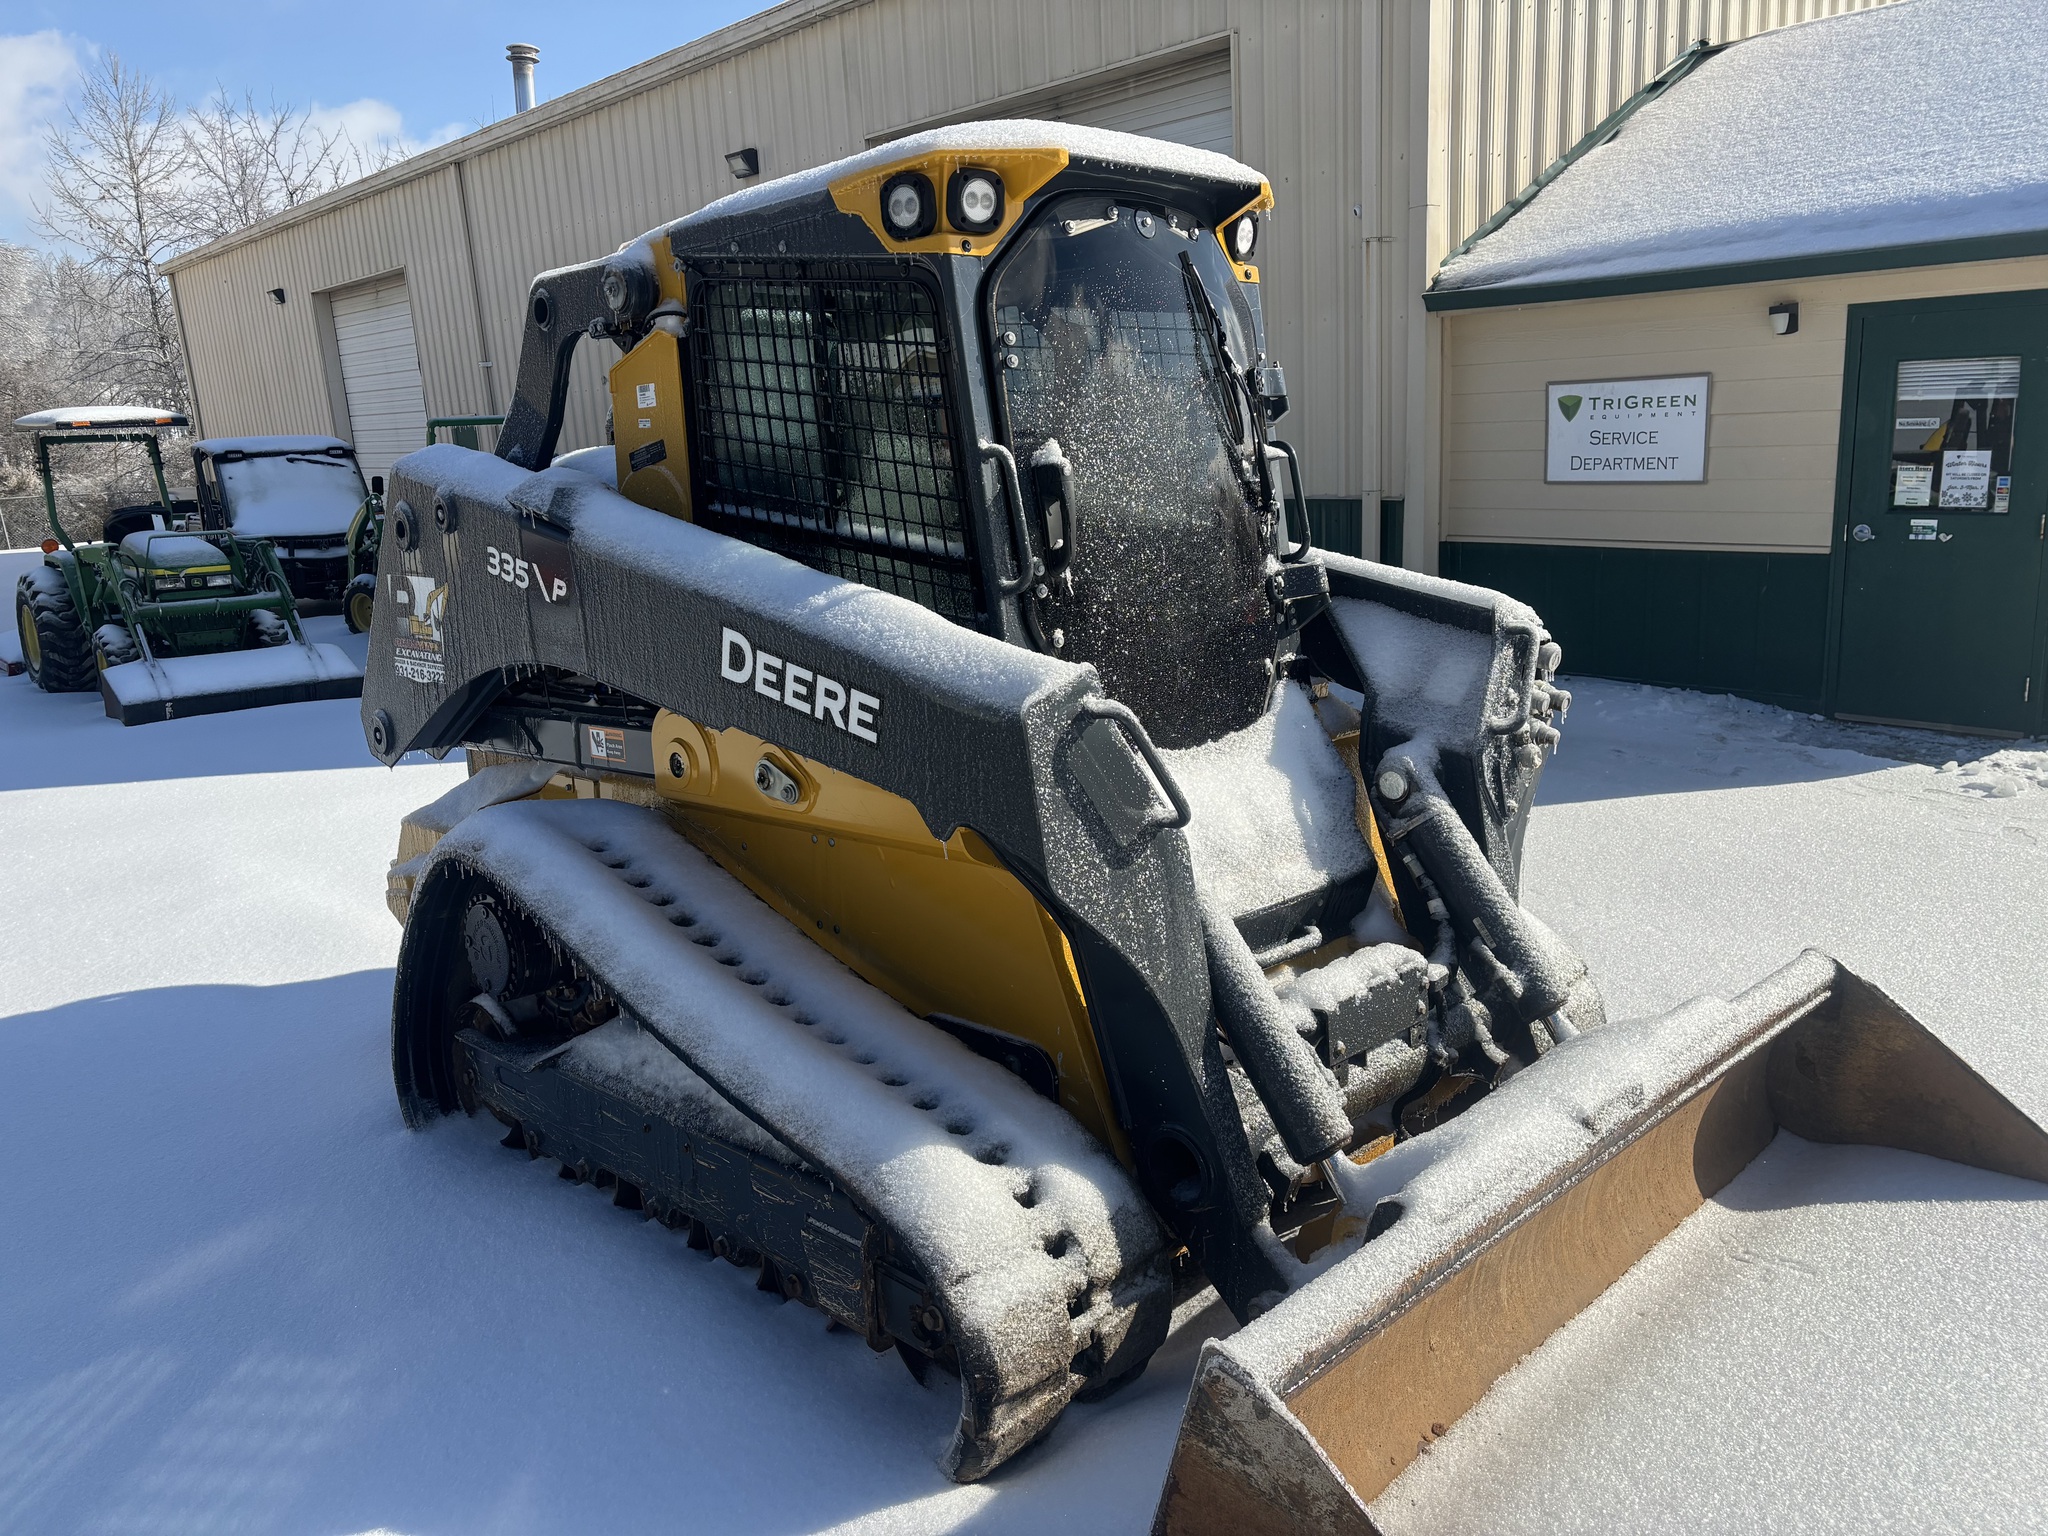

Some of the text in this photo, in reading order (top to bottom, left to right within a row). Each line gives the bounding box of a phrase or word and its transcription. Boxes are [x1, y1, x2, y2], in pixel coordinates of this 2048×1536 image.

[1589, 394, 1697, 411] TRIGREEN
[1590, 411, 1696, 420] EQUIPMENT
[1589, 430, 1659, 446] SERVICE
[1570, 455, 1679, 471] DEPARTMENT
[1967, 460, 1987, 468] Hours
[486, 546, 530, 589] 335
[396, 648, 442, 662] EXCAVATING
[721, 626, 880, 744] DEERE
